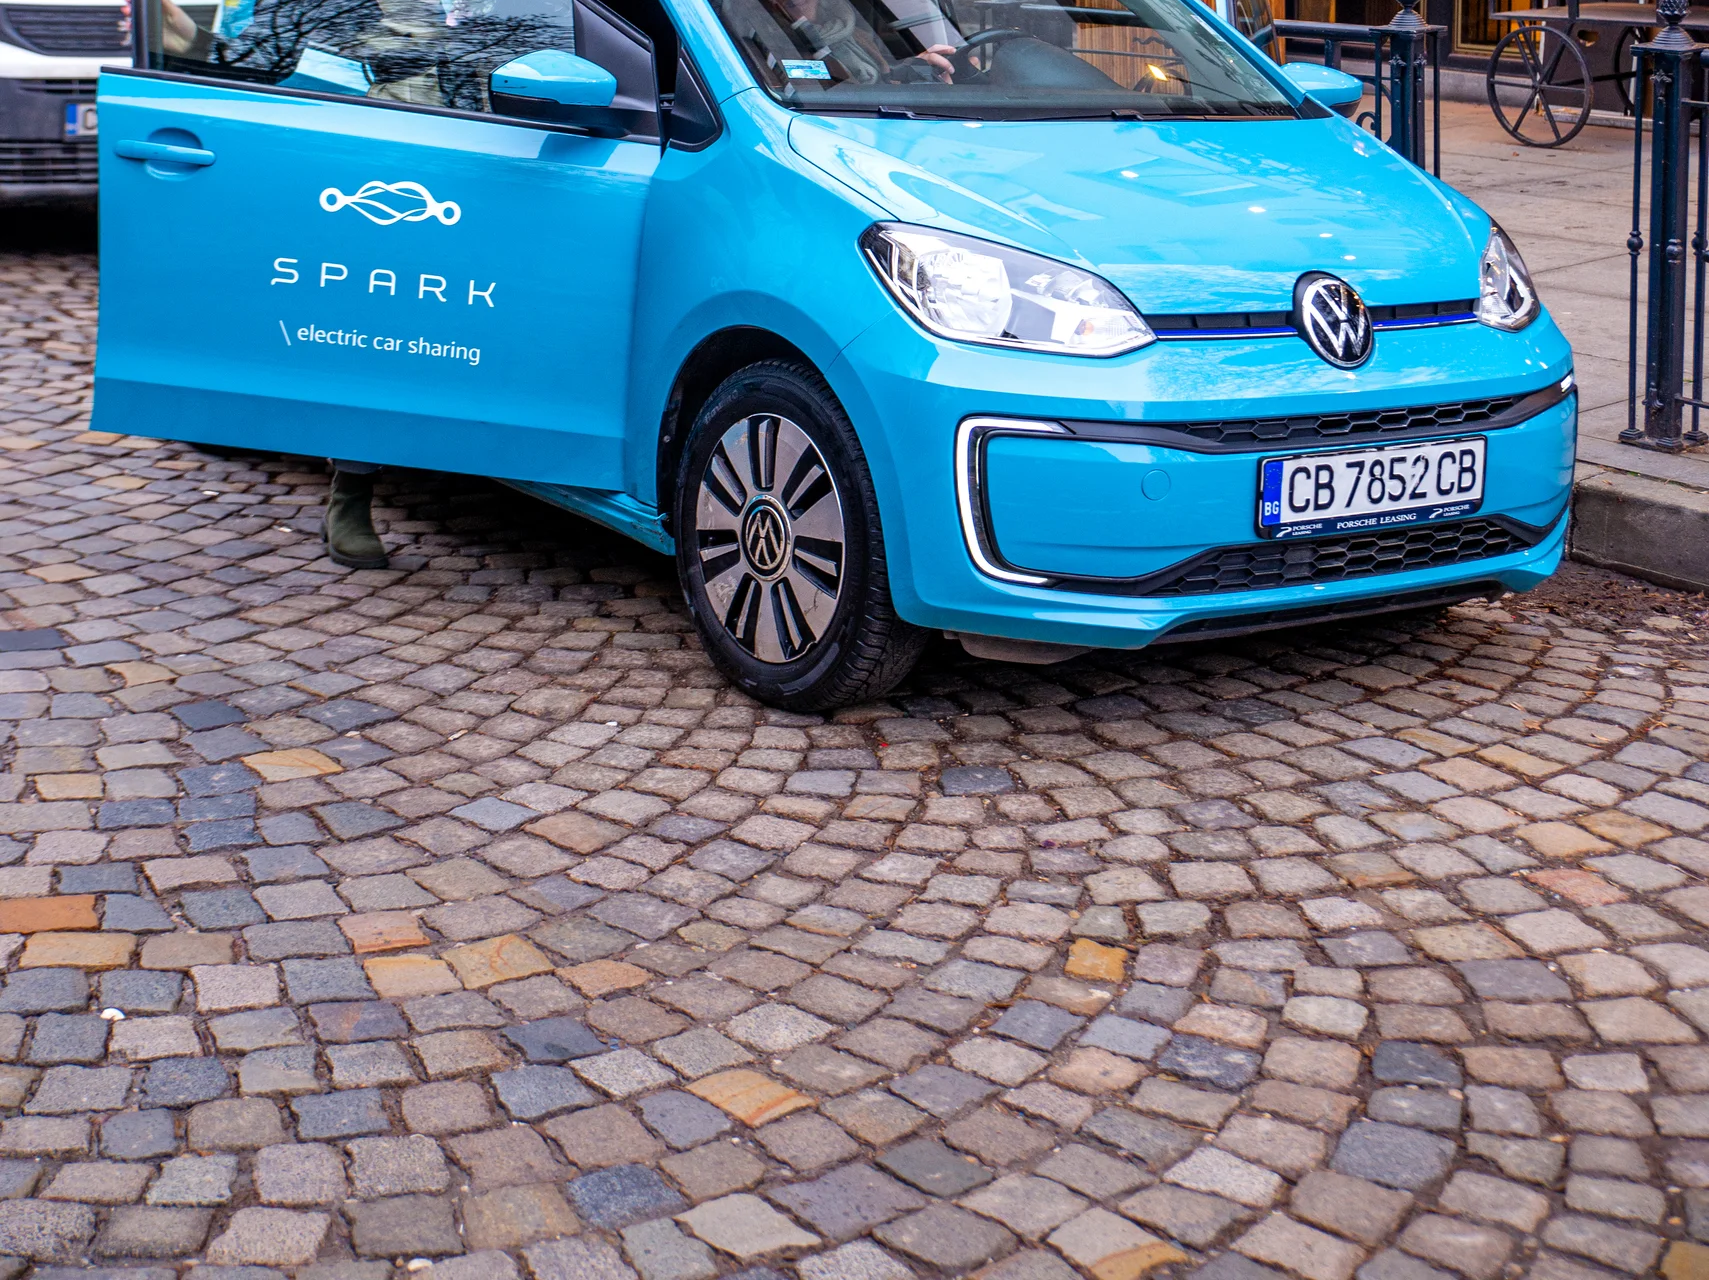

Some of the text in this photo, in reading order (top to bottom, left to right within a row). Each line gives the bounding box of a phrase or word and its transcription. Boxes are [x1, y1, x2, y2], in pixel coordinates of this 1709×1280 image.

[270, 257, 496, 308] SPARK
[297, 324, 368, 348] electric
[373, 336, 403, 352] car
[408, 337, 481, 366] sharing
[1288, 448, 1476, 514] CB 7852 CB
[1264, 501, 1279, 516] BG
[1337, 513, 1417, 529] PORSCHE LEASING
[1292, 523, 1323, 531] PORSCHE
